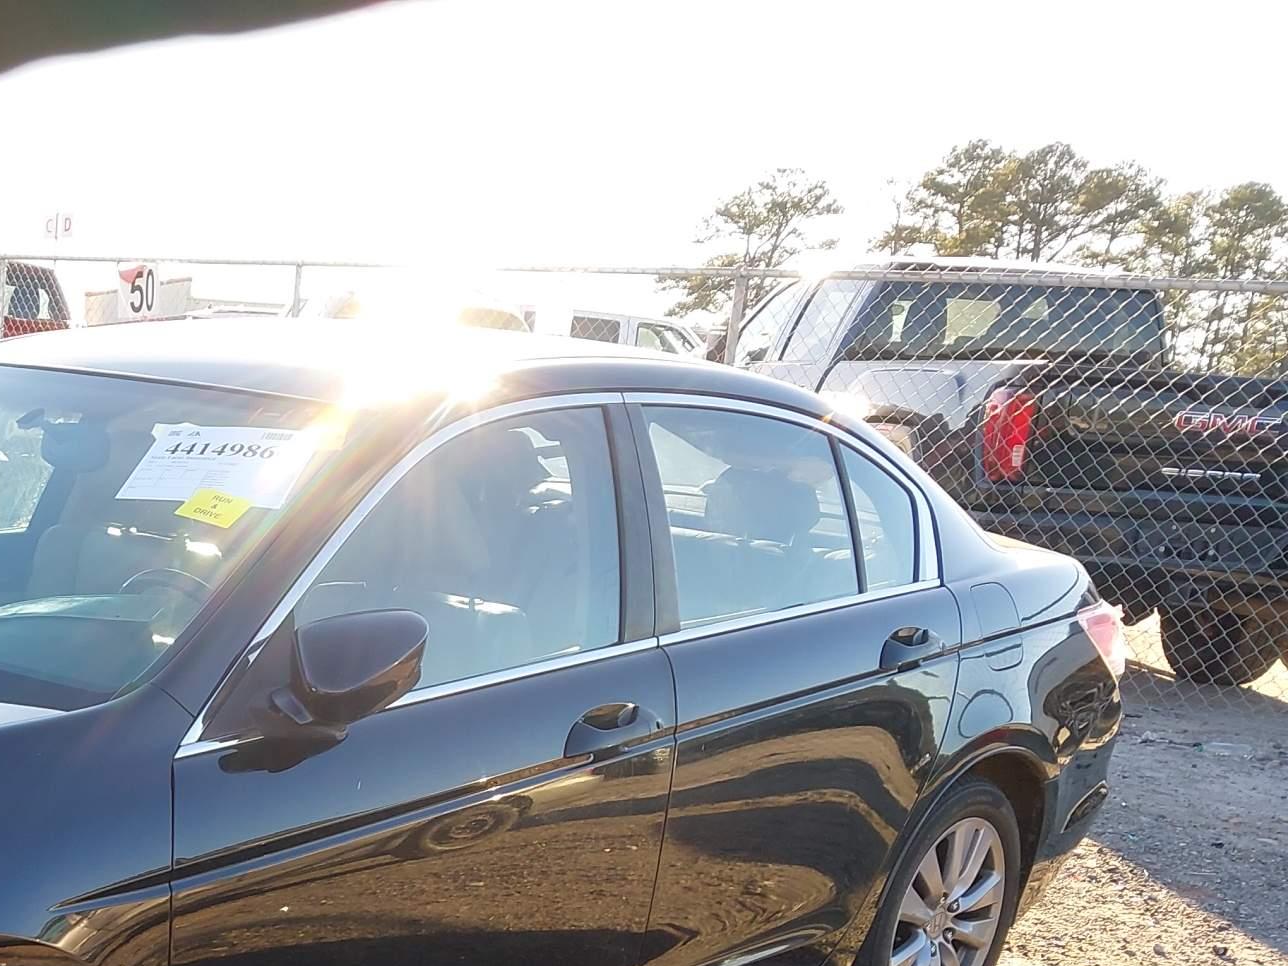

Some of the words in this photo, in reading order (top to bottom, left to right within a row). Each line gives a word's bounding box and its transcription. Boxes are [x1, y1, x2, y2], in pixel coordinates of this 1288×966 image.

[64, 217, 72, 232] D
[129, 268, 155, 313] 50
[1174, 410, 1282, 435] GMC
[193, 507, 223, 519] DRIVE
